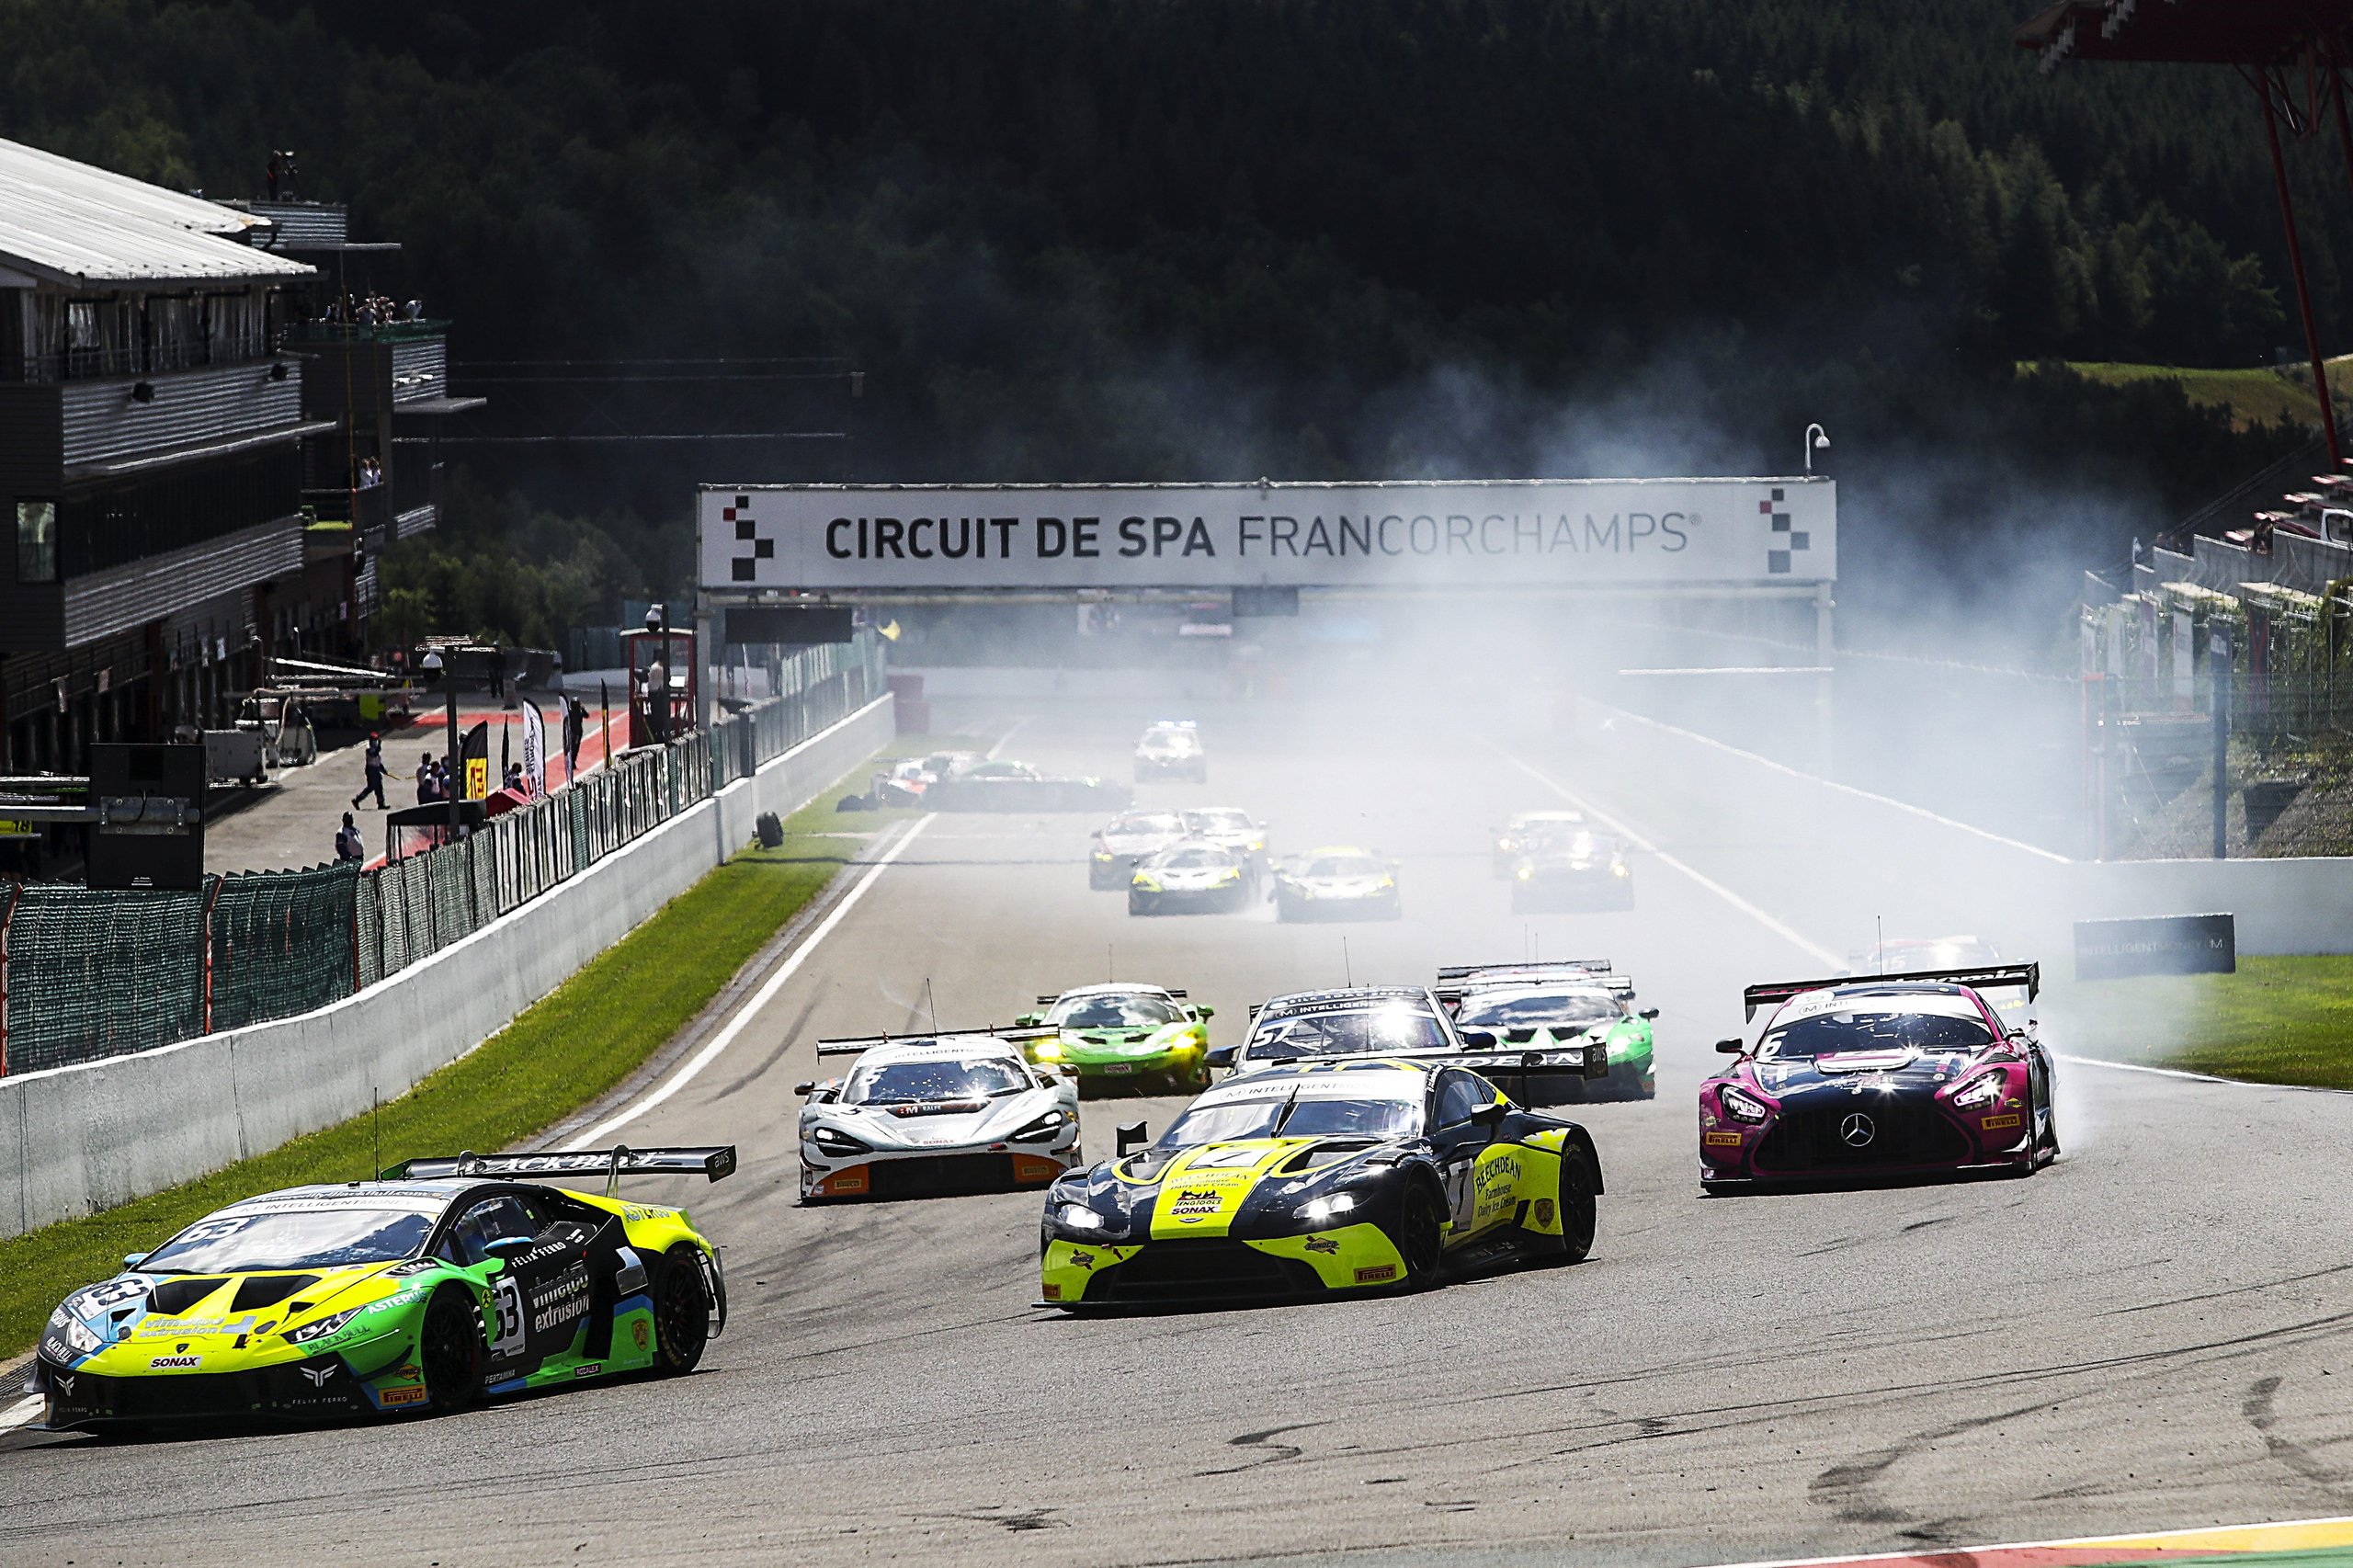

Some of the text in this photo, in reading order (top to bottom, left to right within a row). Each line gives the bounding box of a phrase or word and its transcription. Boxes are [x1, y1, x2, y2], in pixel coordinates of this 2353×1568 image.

[825, 516, 1018, 560] CIRCUIT
[1036, 517, 1100, 559] DE
[1116, 515, 1217, 558] SPA
[1759, 1030, 1789, 1056] 6
[1592, 1046, 1607, 1062] aws
[1985, 1115, 2019, 1129] PIRELLI
[1708, 1133, 1739, 1146] PIRELLI
[713, 1152, 731, 1169] aws
[1475, 1156, 1522, 1195] BEECHDEAN
[1456, 1166, 1470, 1216] 7
[1485, 1182, 1512, 1201] Farmhouse
[263, 1198, 415, 1211] INTELLIGENTMONEY
[1171, 1206, 1220, 1215] SONAX
[1477, 1196, 1517, 1218] Dairy Ice Cream
[178, 1216, 251, 1244] 63
[1305, 1241, 1340, 1251] SUNOCO
[511, 1241, 567, 1268] FELIX FERRO
[1358, 1266, 1395, 1281] PIRELLI
[535, 1292, 589, 1333] extrusion
[138, 1325, 219, 1338] extrusion
[150, 1357, 199, 1368] SONAX
[322, 1395, 347, 1403] FERRO
[382, 1387, 423, 1403] PIRELLI
